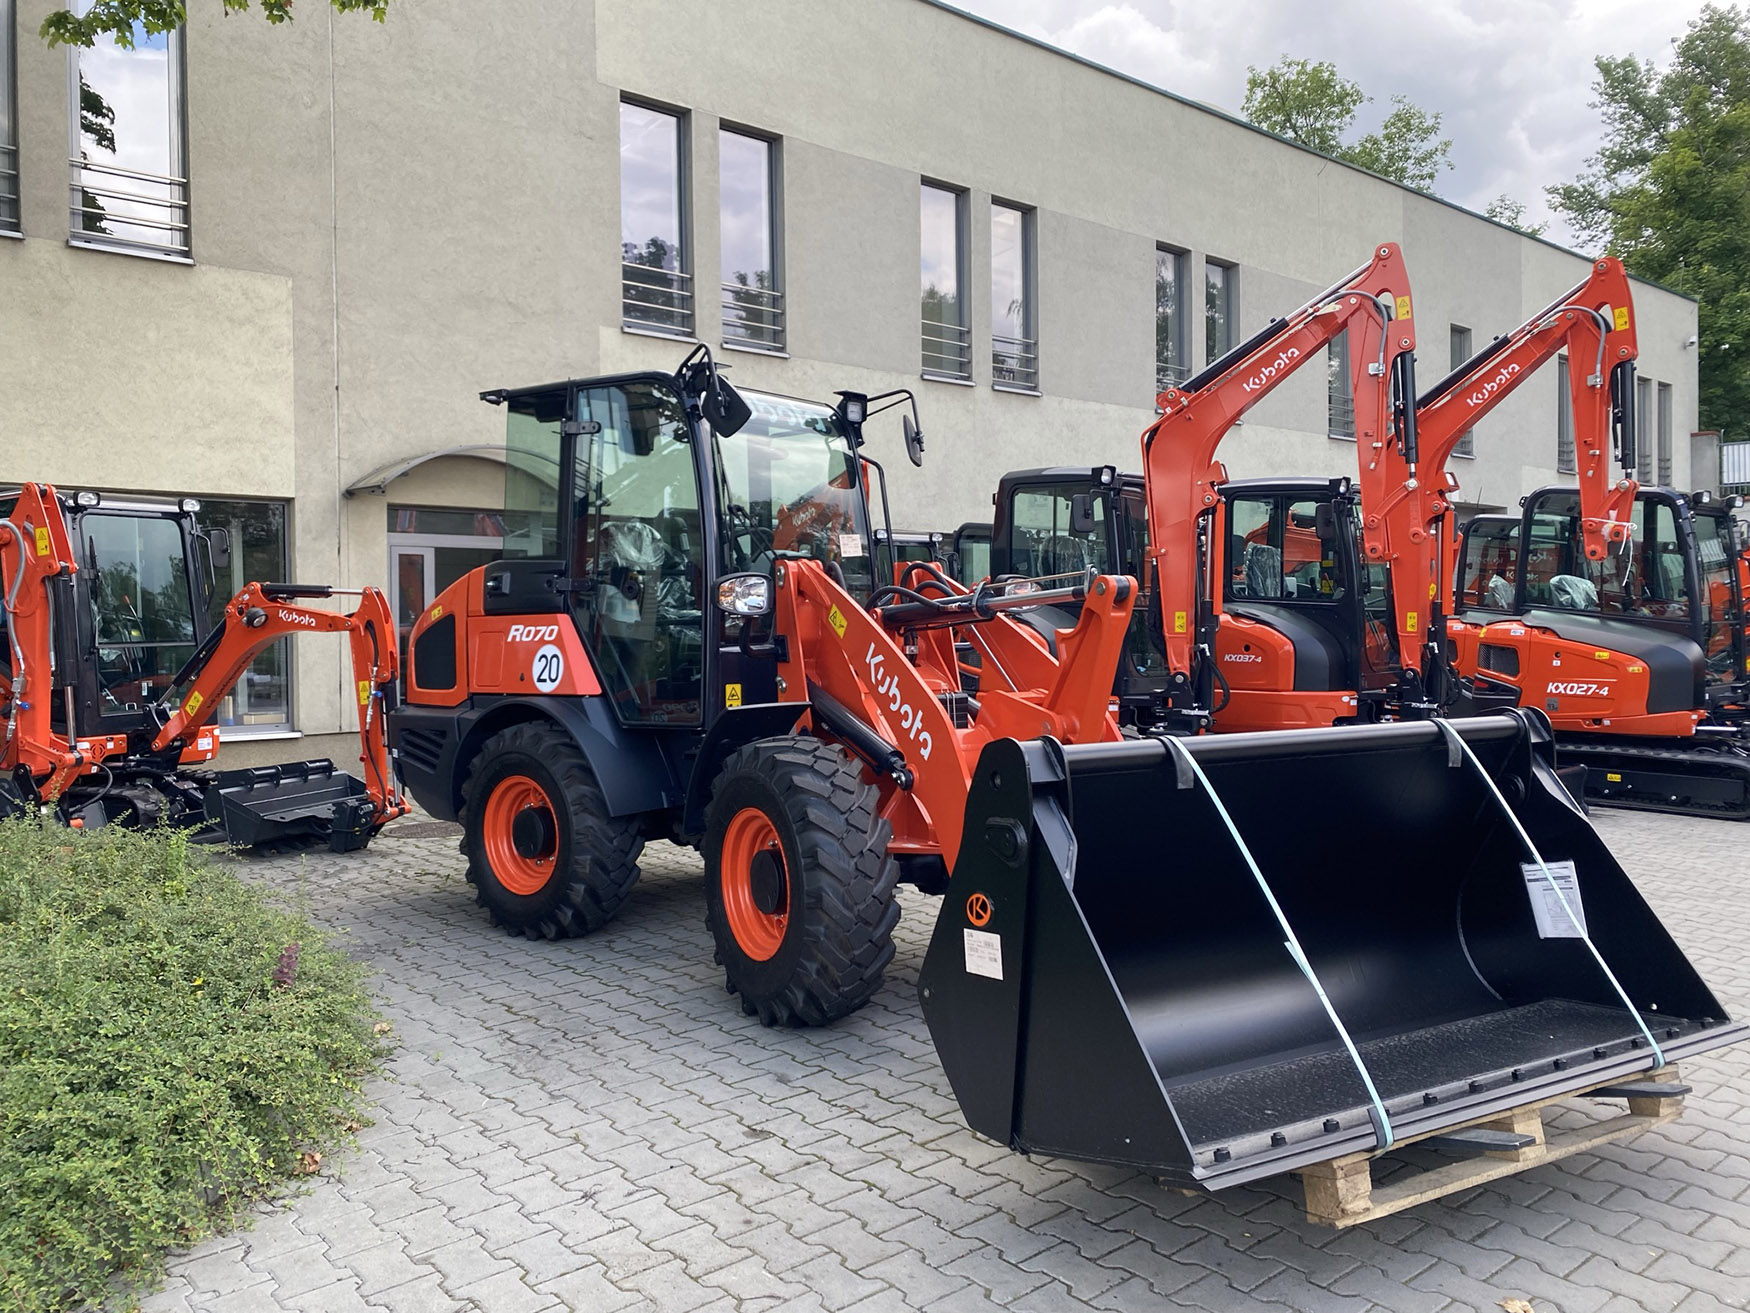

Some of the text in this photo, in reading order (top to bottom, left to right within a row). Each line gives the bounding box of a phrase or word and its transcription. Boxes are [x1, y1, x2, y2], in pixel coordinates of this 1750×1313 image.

[1242, 347, 1300, 392] Kubota
[1466, 363, 1520, 407] Kubota
[278, 609, 316, 626] Kubota
[506, 624, 559, 642] R070
[536, 653, 560, 683] 20
[1223, 653, 1262, 663] KX037-4
[865, 641, 932, 761] Kubota
[1546, 682, 1609, 696] KX027-4
